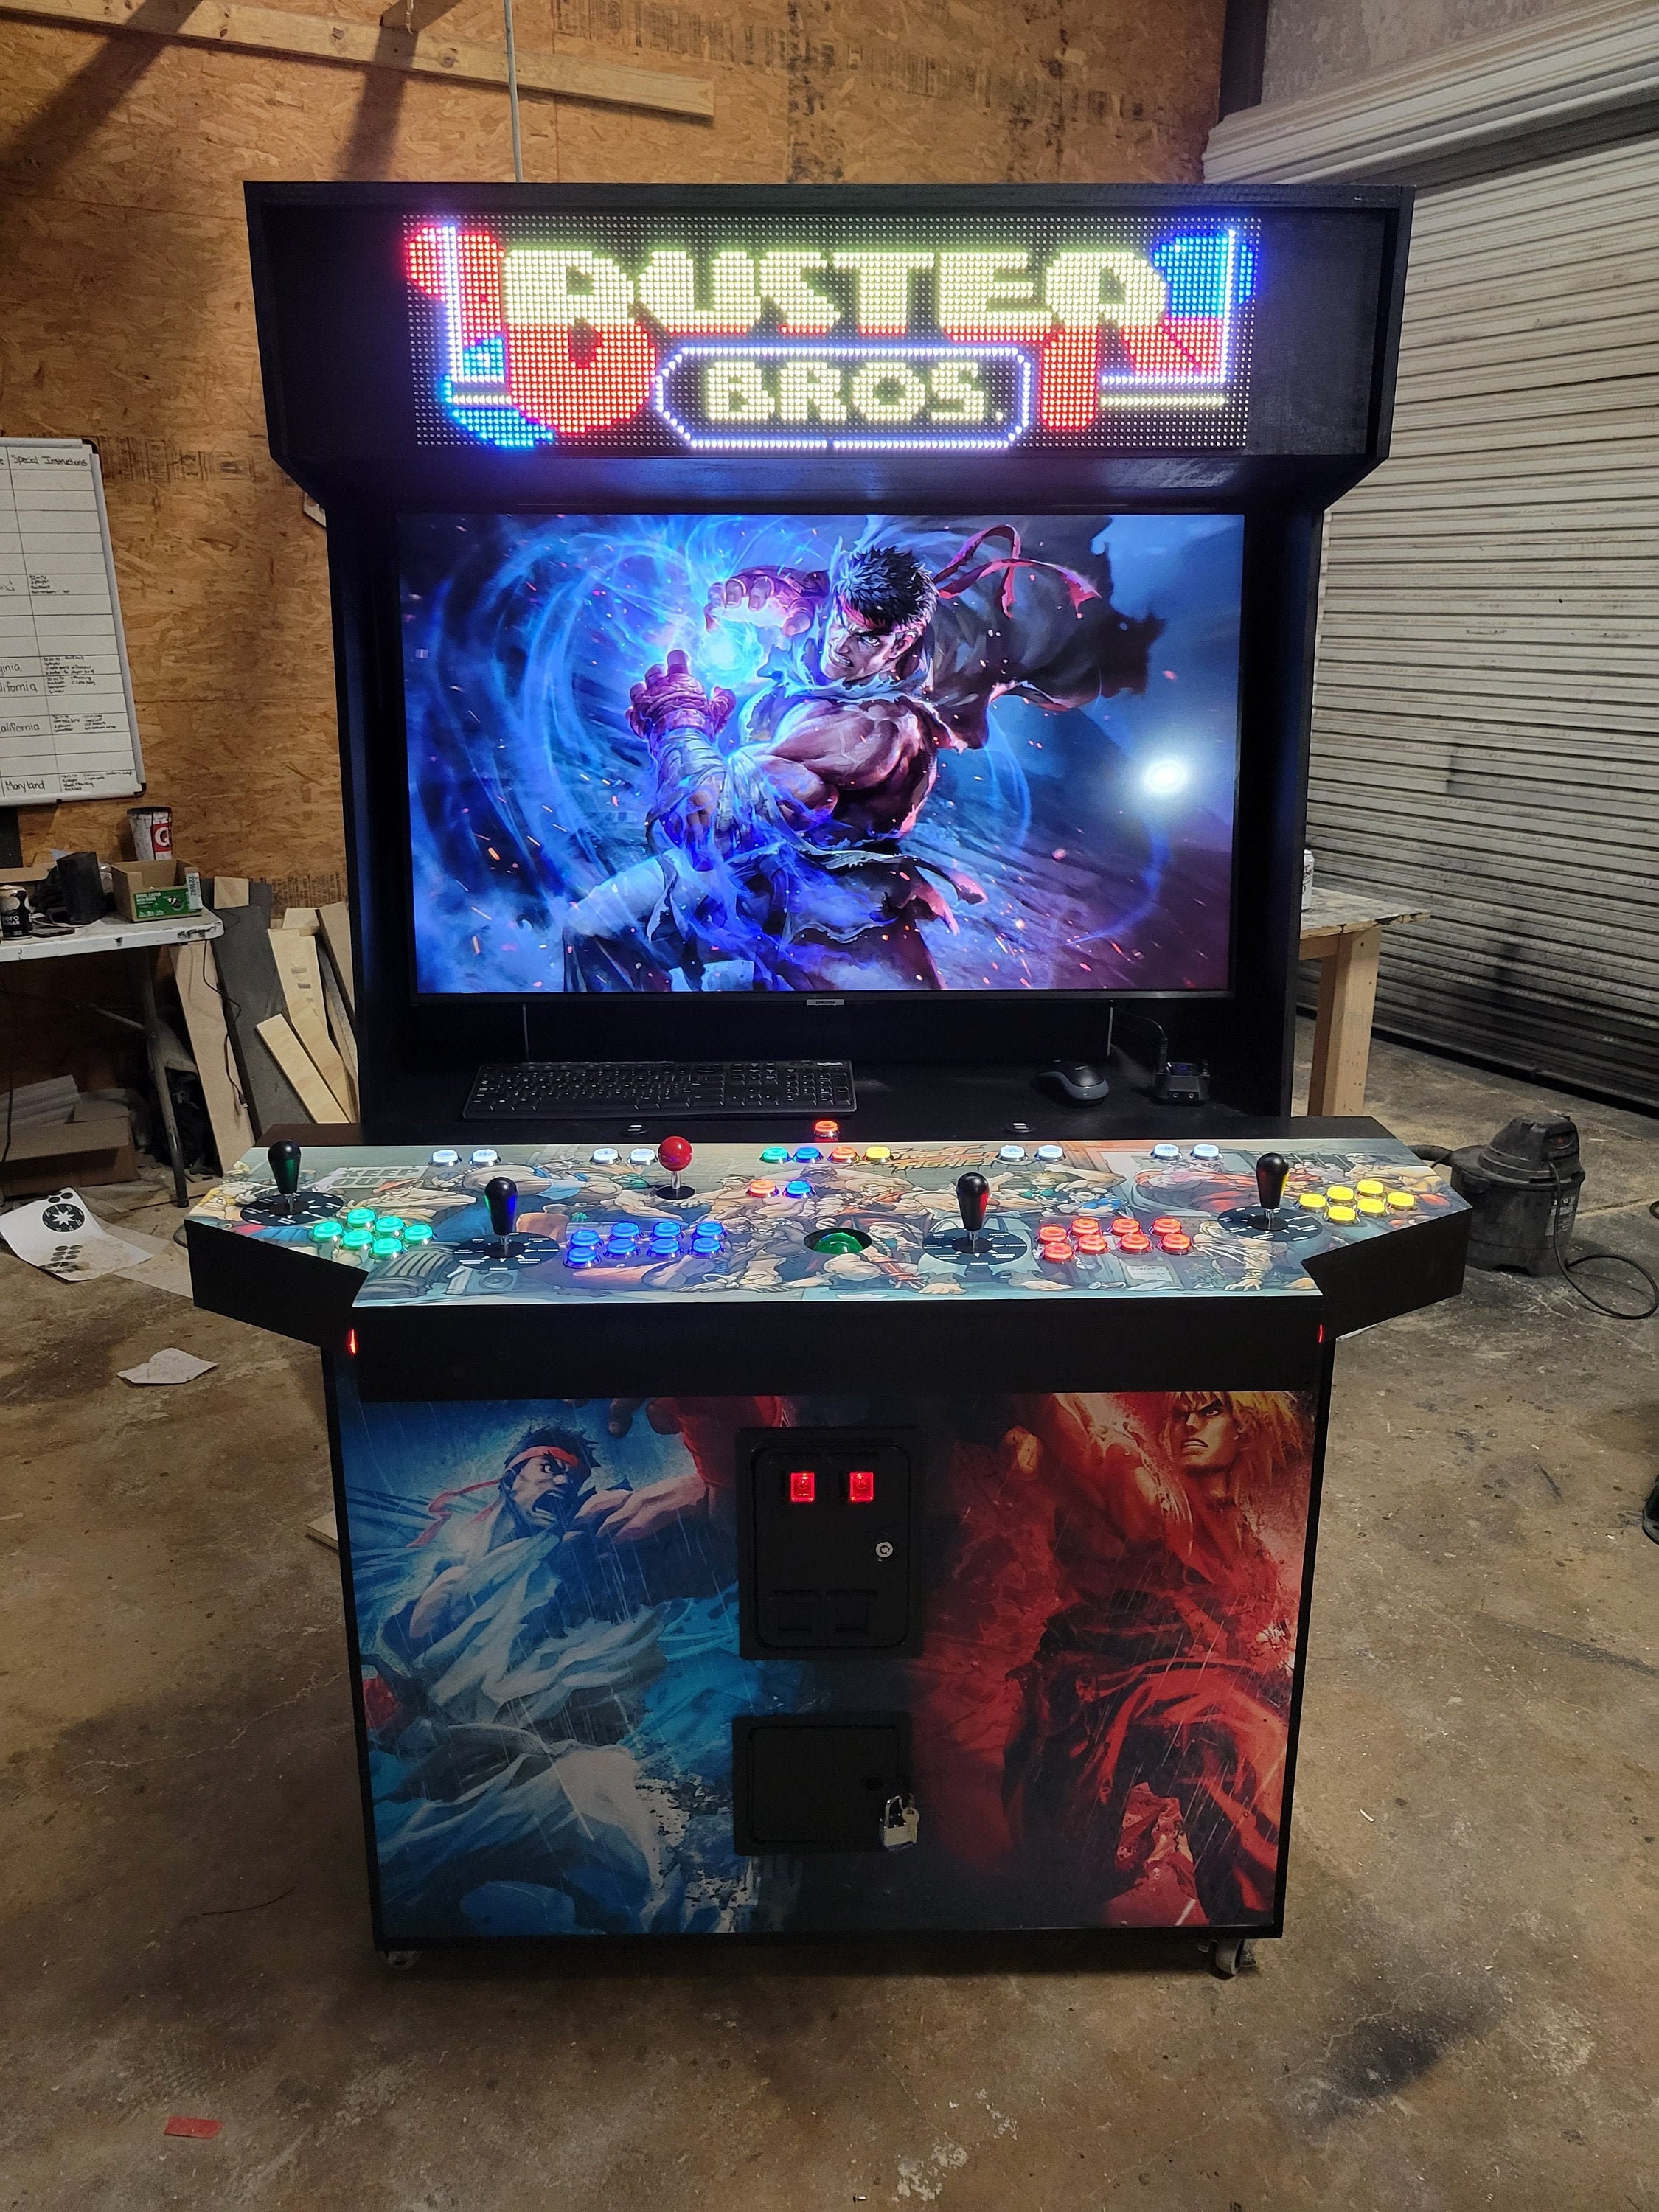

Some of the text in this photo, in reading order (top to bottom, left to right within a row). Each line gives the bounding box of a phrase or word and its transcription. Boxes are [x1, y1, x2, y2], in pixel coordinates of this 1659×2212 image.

[503, 248, 1180, 435] BUSTER
[706, 360, 1005, 424] BROS.
[10, 454, 40, 465] Special
[0, 722, 40, 733] alifornia
[5, 780, 46, 793] Maryland
[342, 1169, 420, 1177] KEEP
